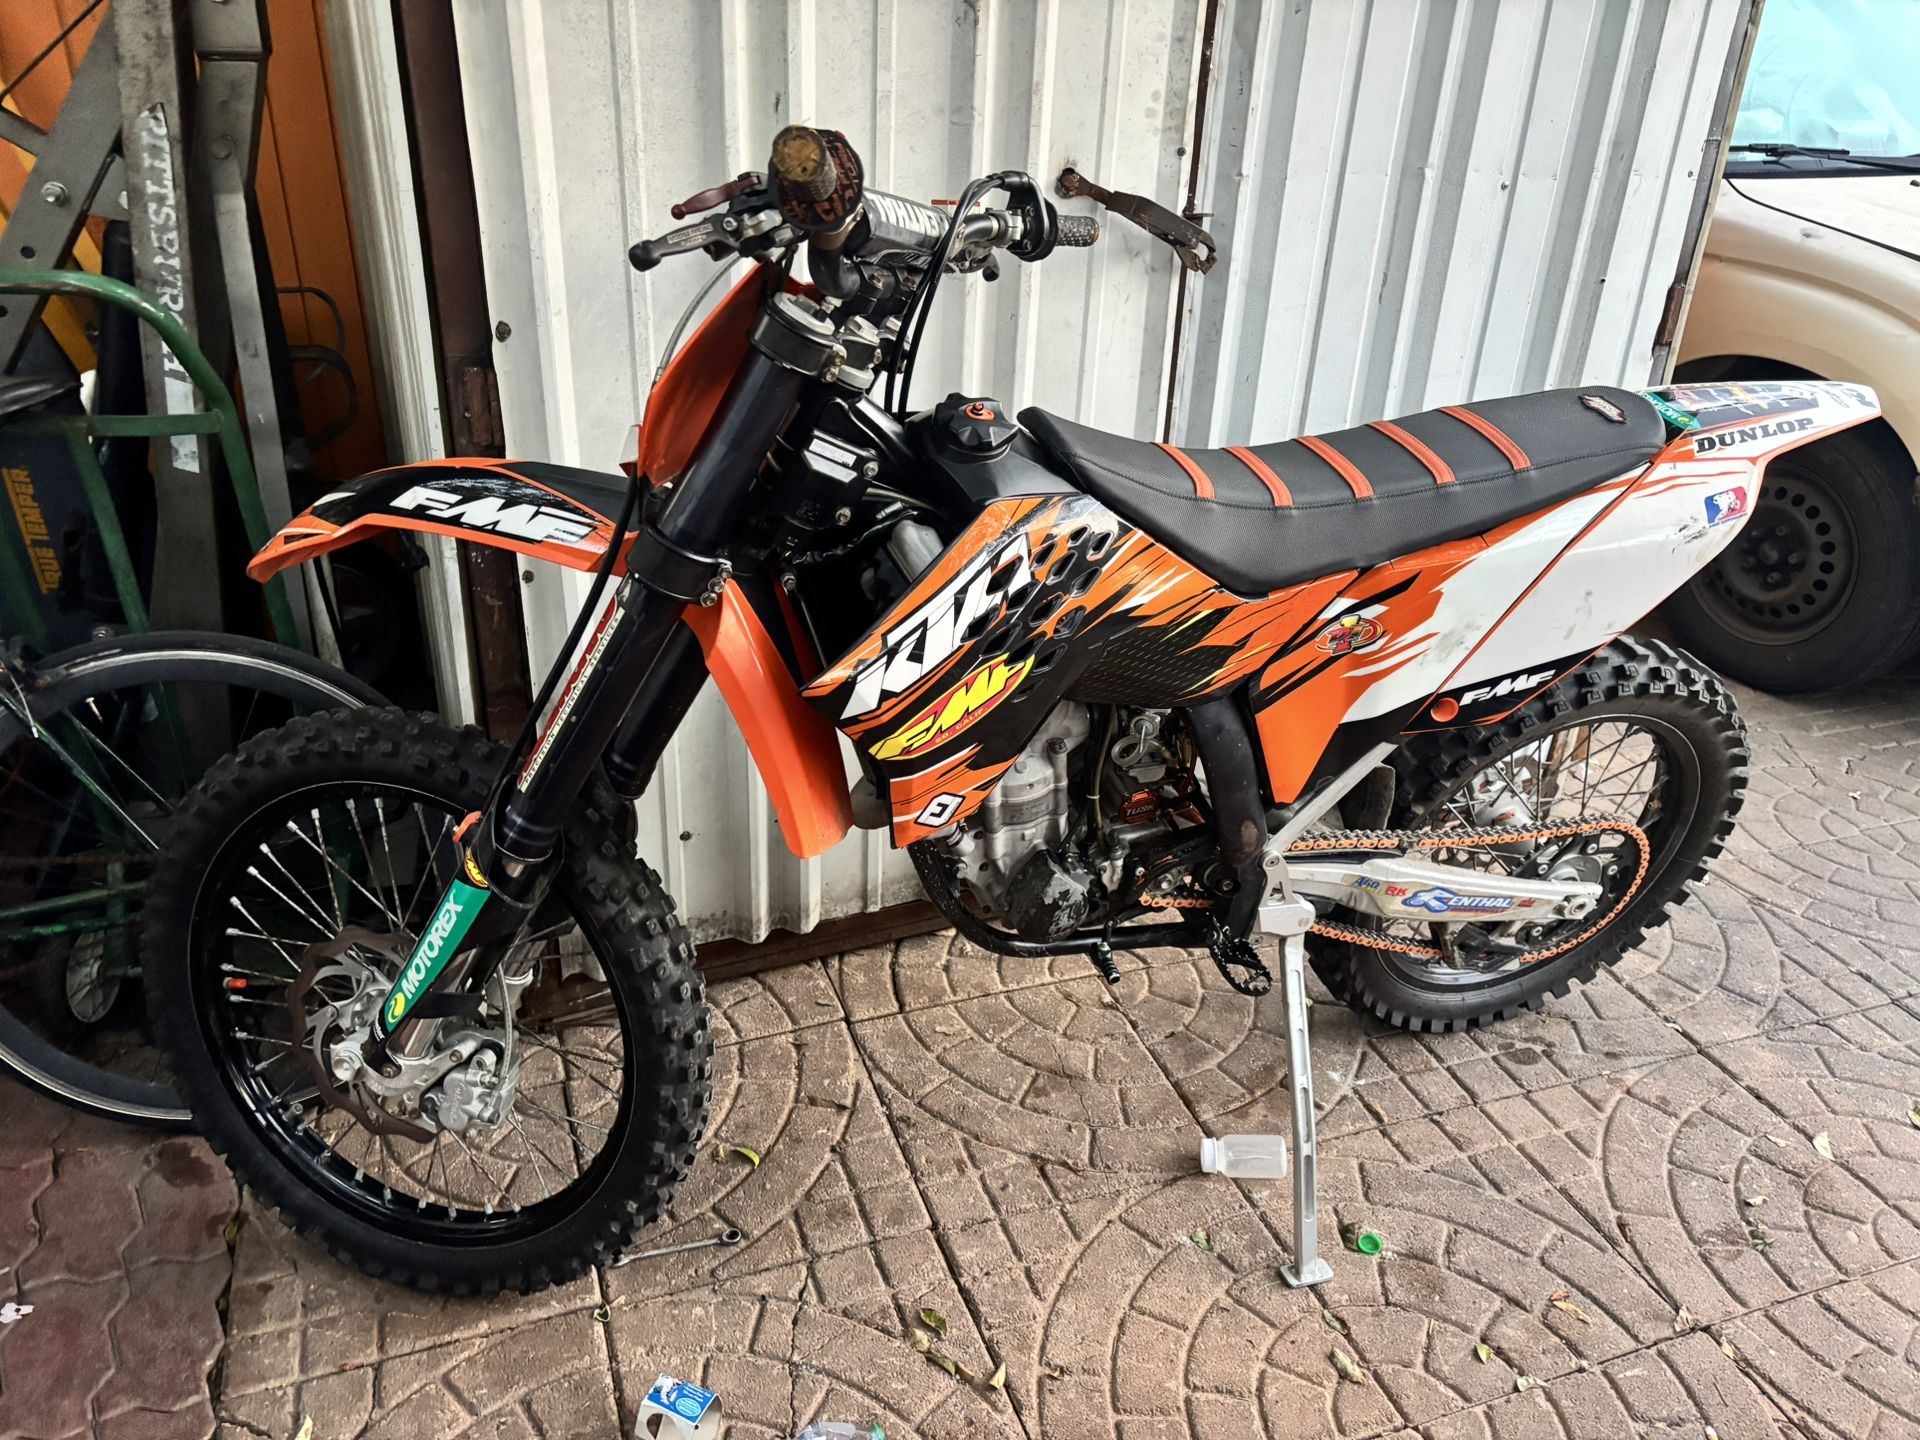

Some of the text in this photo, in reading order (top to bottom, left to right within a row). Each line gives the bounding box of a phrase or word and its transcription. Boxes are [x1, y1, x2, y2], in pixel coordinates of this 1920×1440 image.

[138, 105, 194, 383] PITTSBURH
[1695, 416, 1814, 454] DUNLOP
[2, 467, 51, 545] TEMPER
[389, 486, 606, 541] FMF
[524, 615, 620, 785] PRECISION TECHNICAL SERVICES
[875, 657, 1027, 760] FMF
[1459, 669, 1556, 706] FMF
[401, 889, 463, 999] MOTOREX
